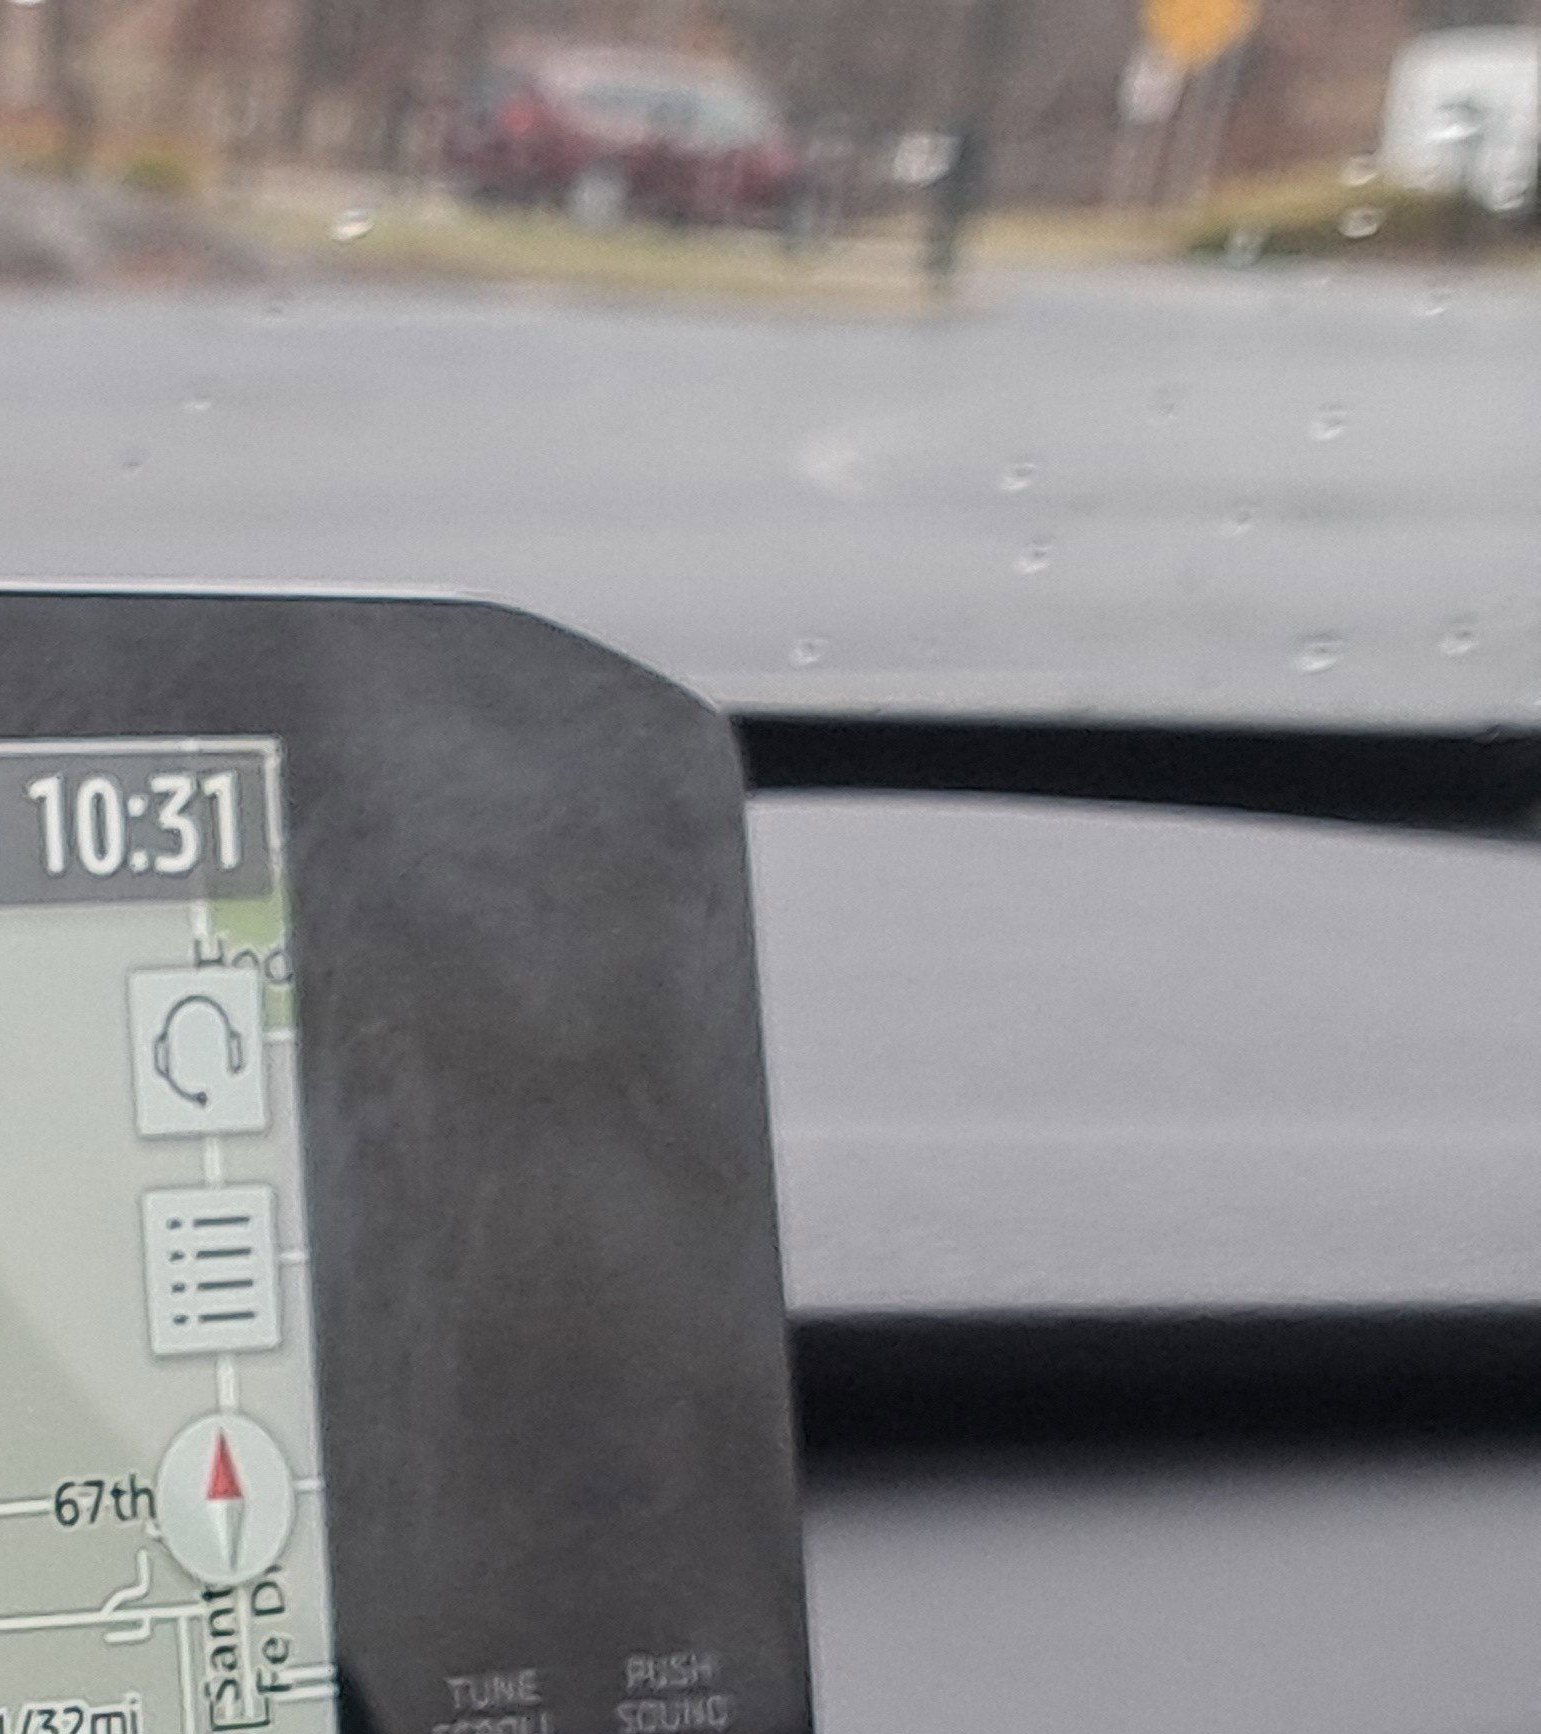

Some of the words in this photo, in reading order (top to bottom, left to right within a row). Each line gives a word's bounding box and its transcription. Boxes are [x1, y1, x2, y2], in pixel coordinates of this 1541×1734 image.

[27, 772, 240, 875] 10:31
[53, 1474, 157, 1527] 67th
[201, 1585, 243, 1704] Sant
[444, 1667, 543, 1709] TUNE
[625, 1652, 716, 1691] PUSH
